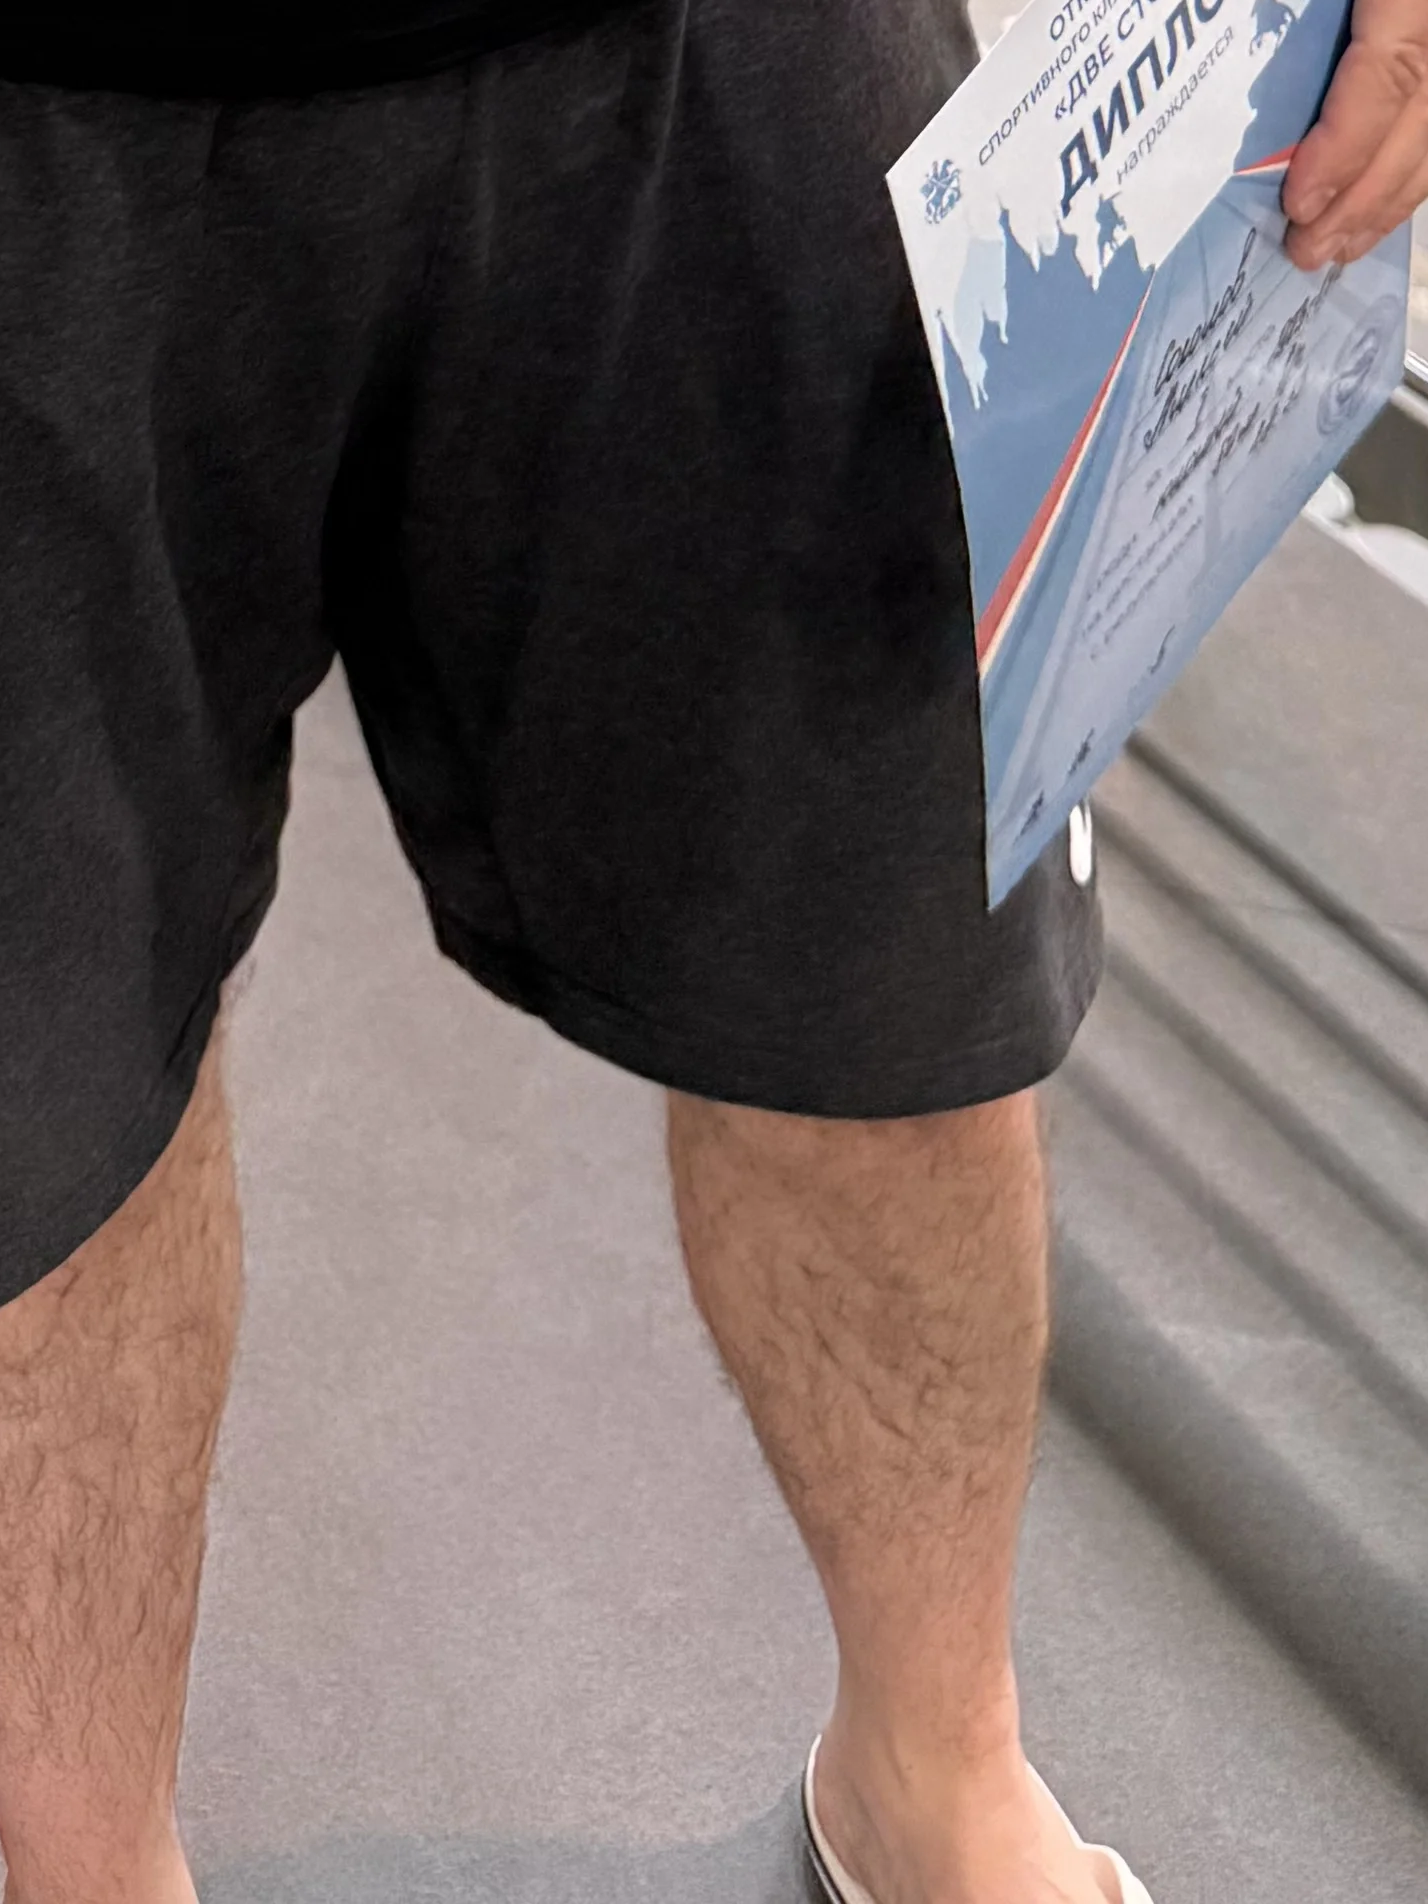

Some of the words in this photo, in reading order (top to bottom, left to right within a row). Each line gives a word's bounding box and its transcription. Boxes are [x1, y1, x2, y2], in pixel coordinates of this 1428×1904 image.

[978, 22, 1091, 166] СПОРТИВНОГО
[1054, 34, 1113, 119] «ДВЕ
[1117, 27, 1233, 184] награждается
